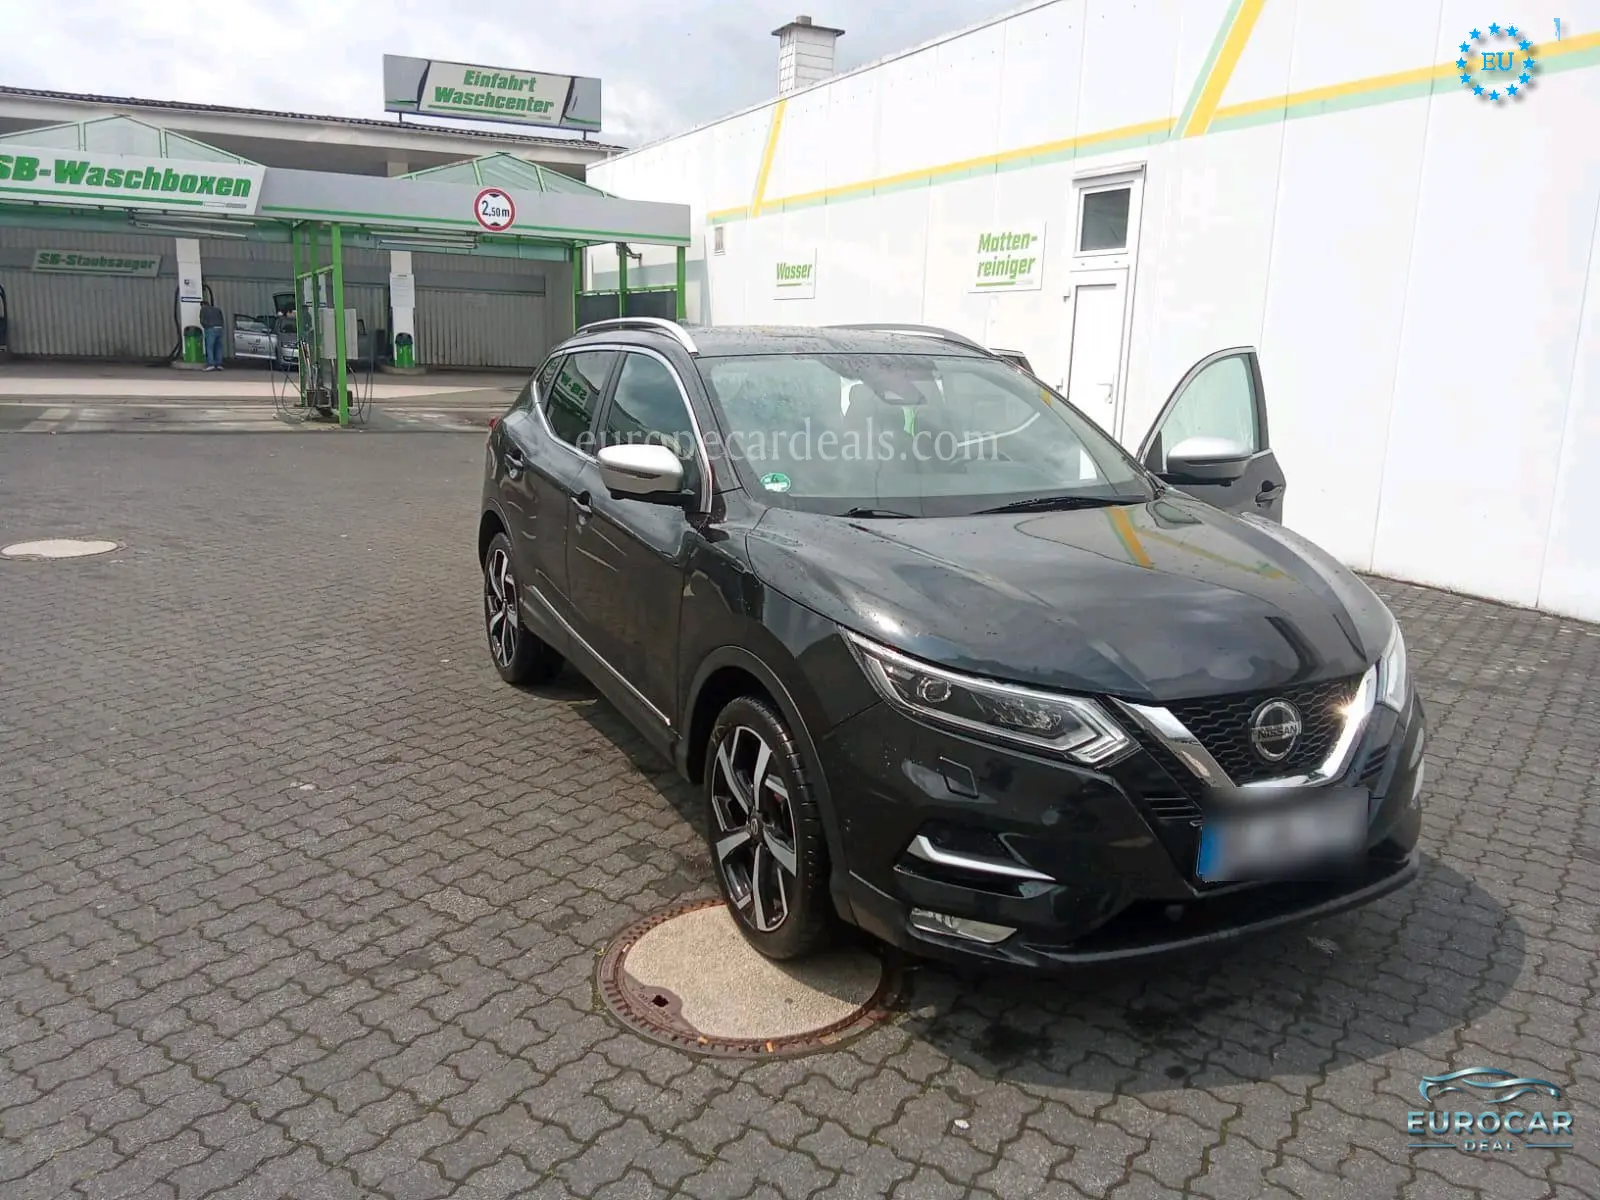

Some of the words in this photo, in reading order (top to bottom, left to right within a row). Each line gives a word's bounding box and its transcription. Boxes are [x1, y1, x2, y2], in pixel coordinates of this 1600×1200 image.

[463, 69, 536, 92] Einfahrt
[434, 86, 554, 113] Waschcenter
[977, 231, 1038, 254] Matten-
[776, 262, 813, 281] Wasser
[977, 254, 1036, 279] reiniger
[1257, 722, 1299, 739] NISSAN
